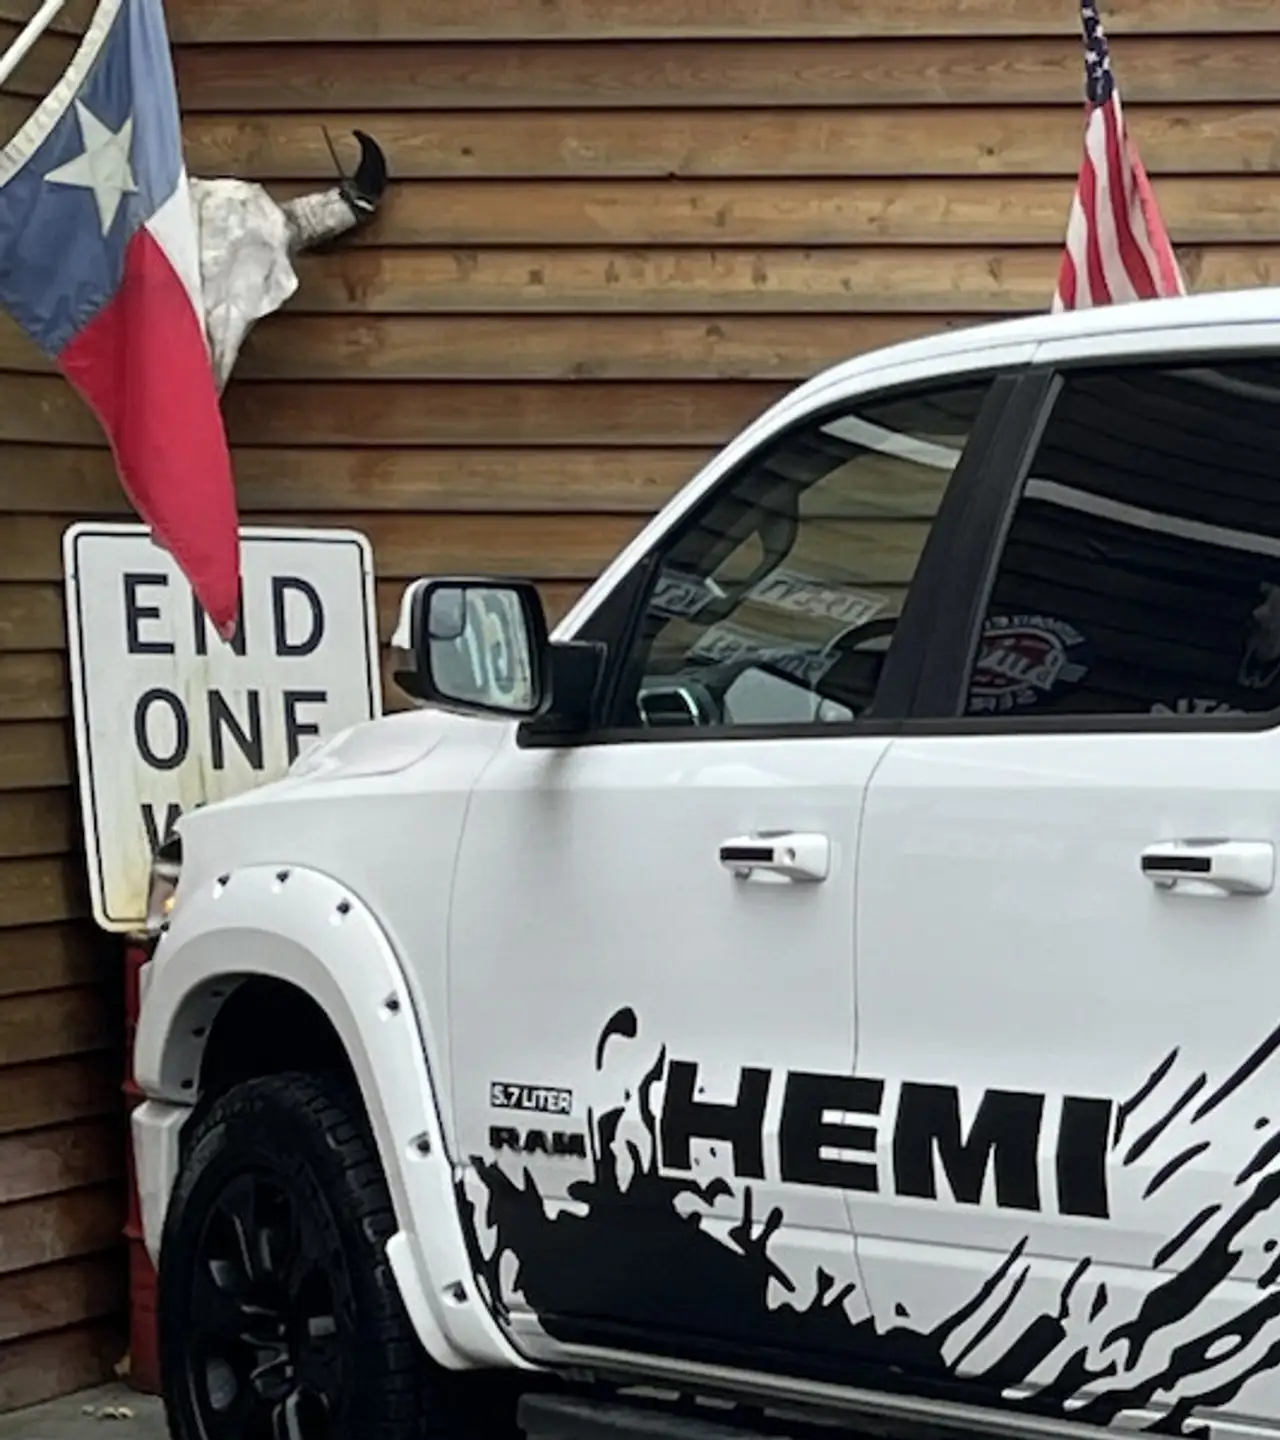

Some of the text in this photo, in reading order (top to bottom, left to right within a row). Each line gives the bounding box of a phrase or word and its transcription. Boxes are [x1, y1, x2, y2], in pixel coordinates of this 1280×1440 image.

[123, 572, 325, 657] END
[134, 687, 328, 771] ONE
[489, 1125, 586, 1159] RAM
[522, 1087, 571, 1113] LITER
[660, 1059, 1113, 1220] HEMI
